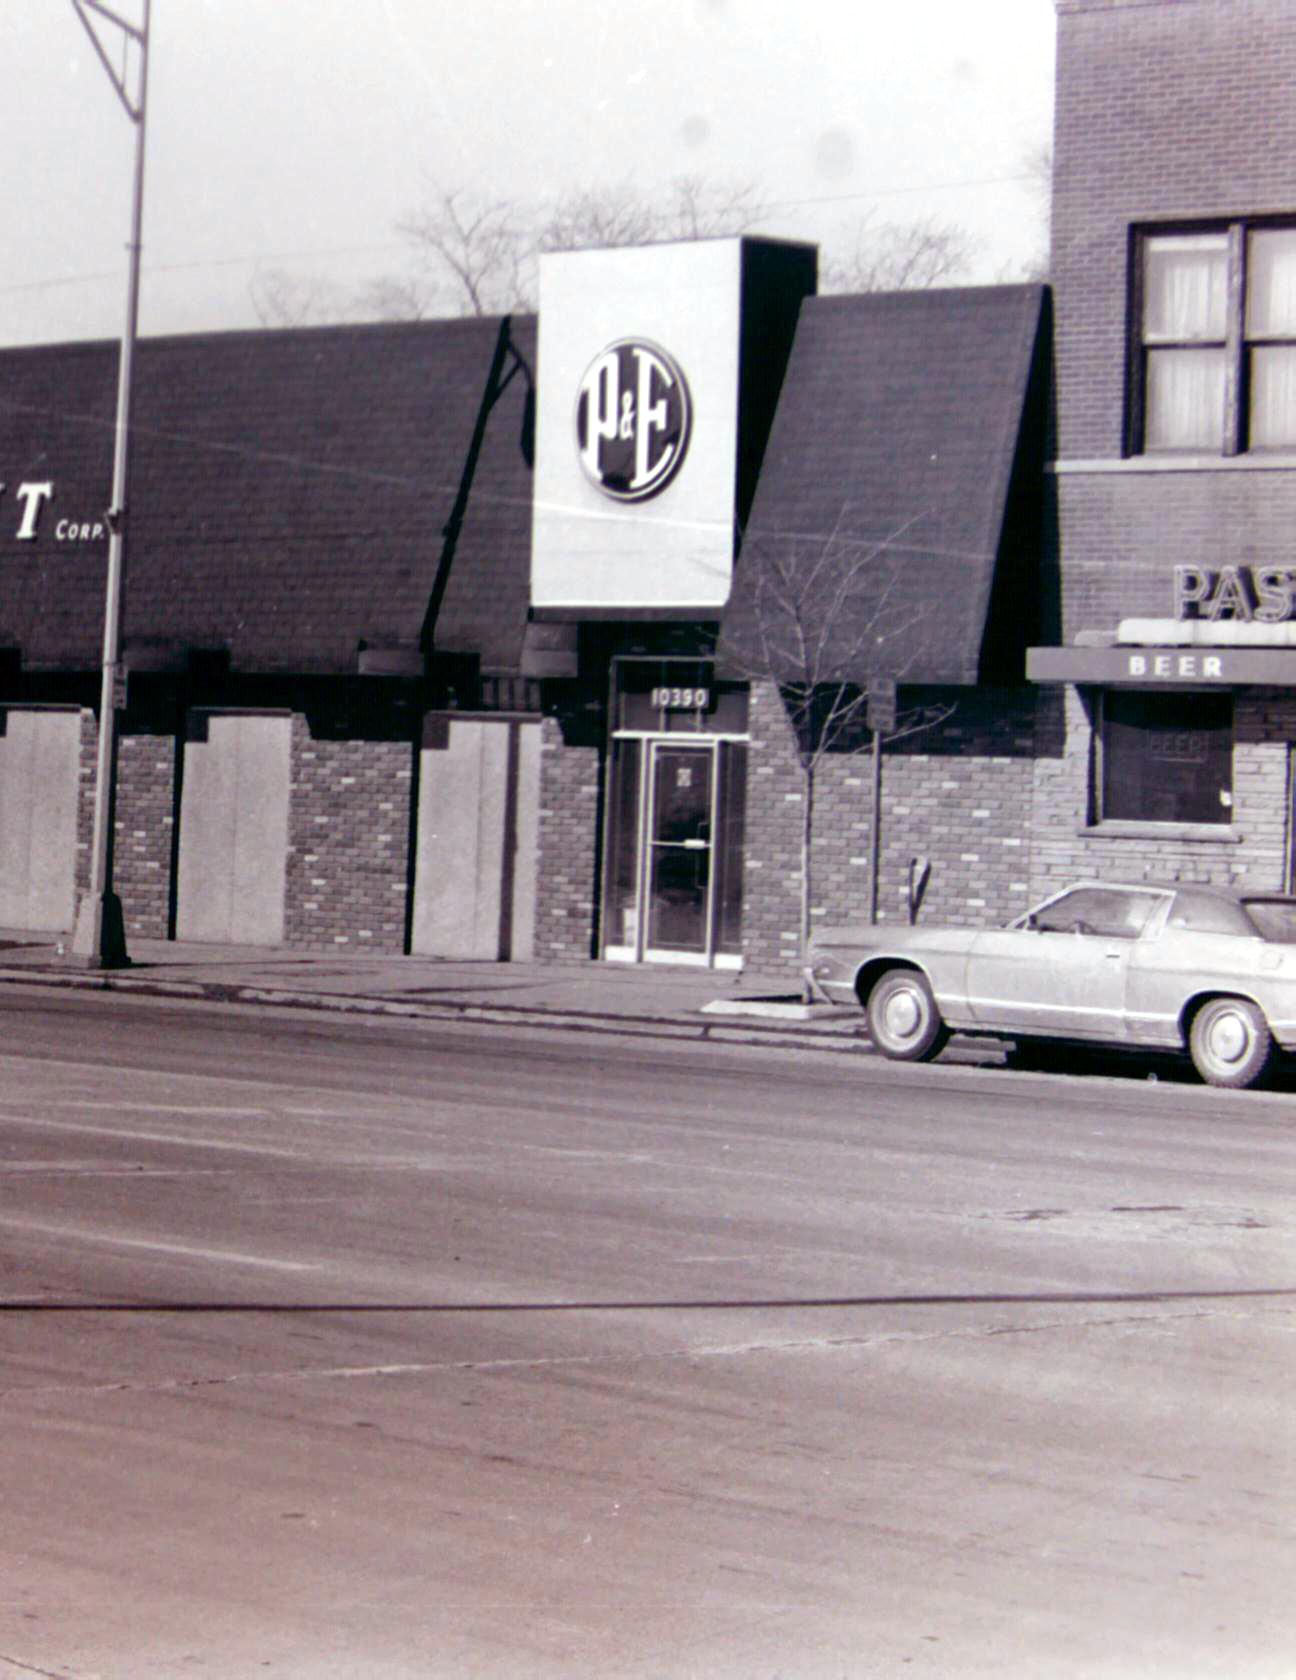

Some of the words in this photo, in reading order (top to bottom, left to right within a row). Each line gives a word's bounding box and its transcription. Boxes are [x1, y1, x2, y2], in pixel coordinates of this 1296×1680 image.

[580, 347, 675, 490] P&E
[1128, 655, 1223, 678] BEER
[651, 687, 707, 707] 10390
